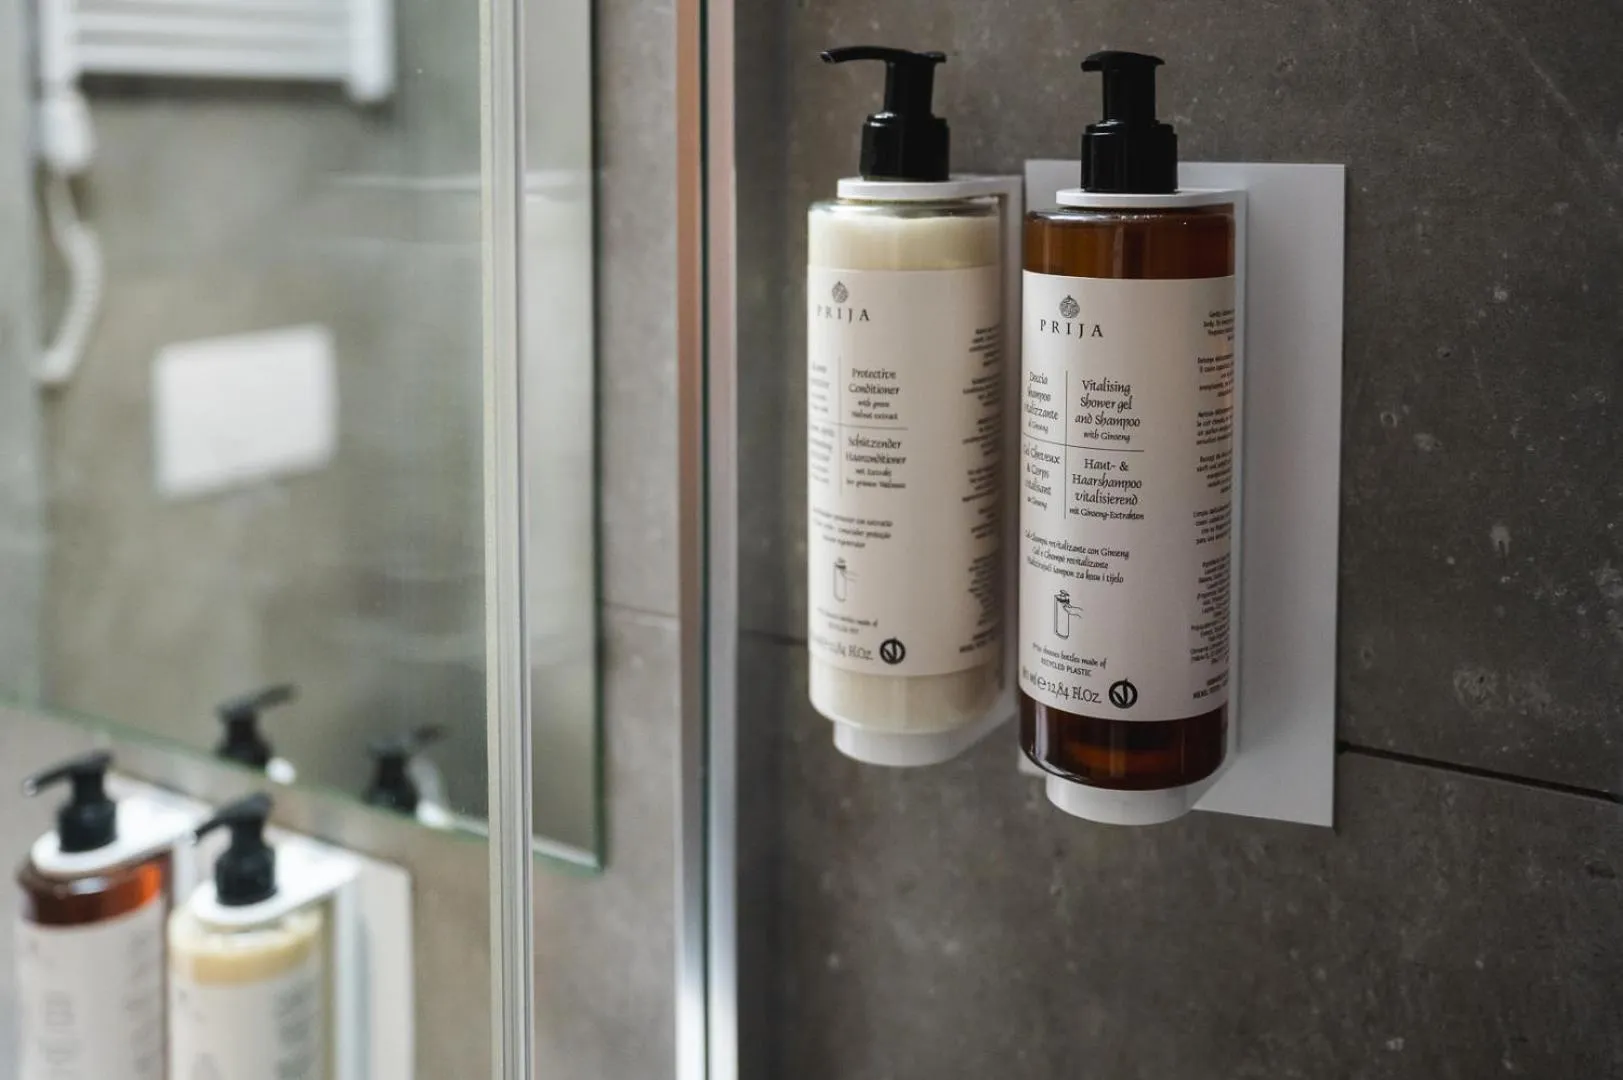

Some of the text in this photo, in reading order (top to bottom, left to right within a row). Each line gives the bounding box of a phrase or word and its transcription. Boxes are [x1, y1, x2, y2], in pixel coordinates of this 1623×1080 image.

[817, 304, 870, 322] PRIJA
[1040, 319, 1104, 338] PRIJA
[852, 368, 897, 379] Protective
[848, 383, 900, 395] Conditioner
[1082, 376, 1131, 396] Vitalising
[1080, 393, 1133, 413] Shower gel
[1074, 410, 1141, 430] and Shampoo
[1083, 428, 1131, 444] with Ginseng
[1084, 458, 1129, 471] Haut- &
[1072, 472, 1142, 493] Haarshampoo
[1075, 489, 1138, 506] vitalisierend
